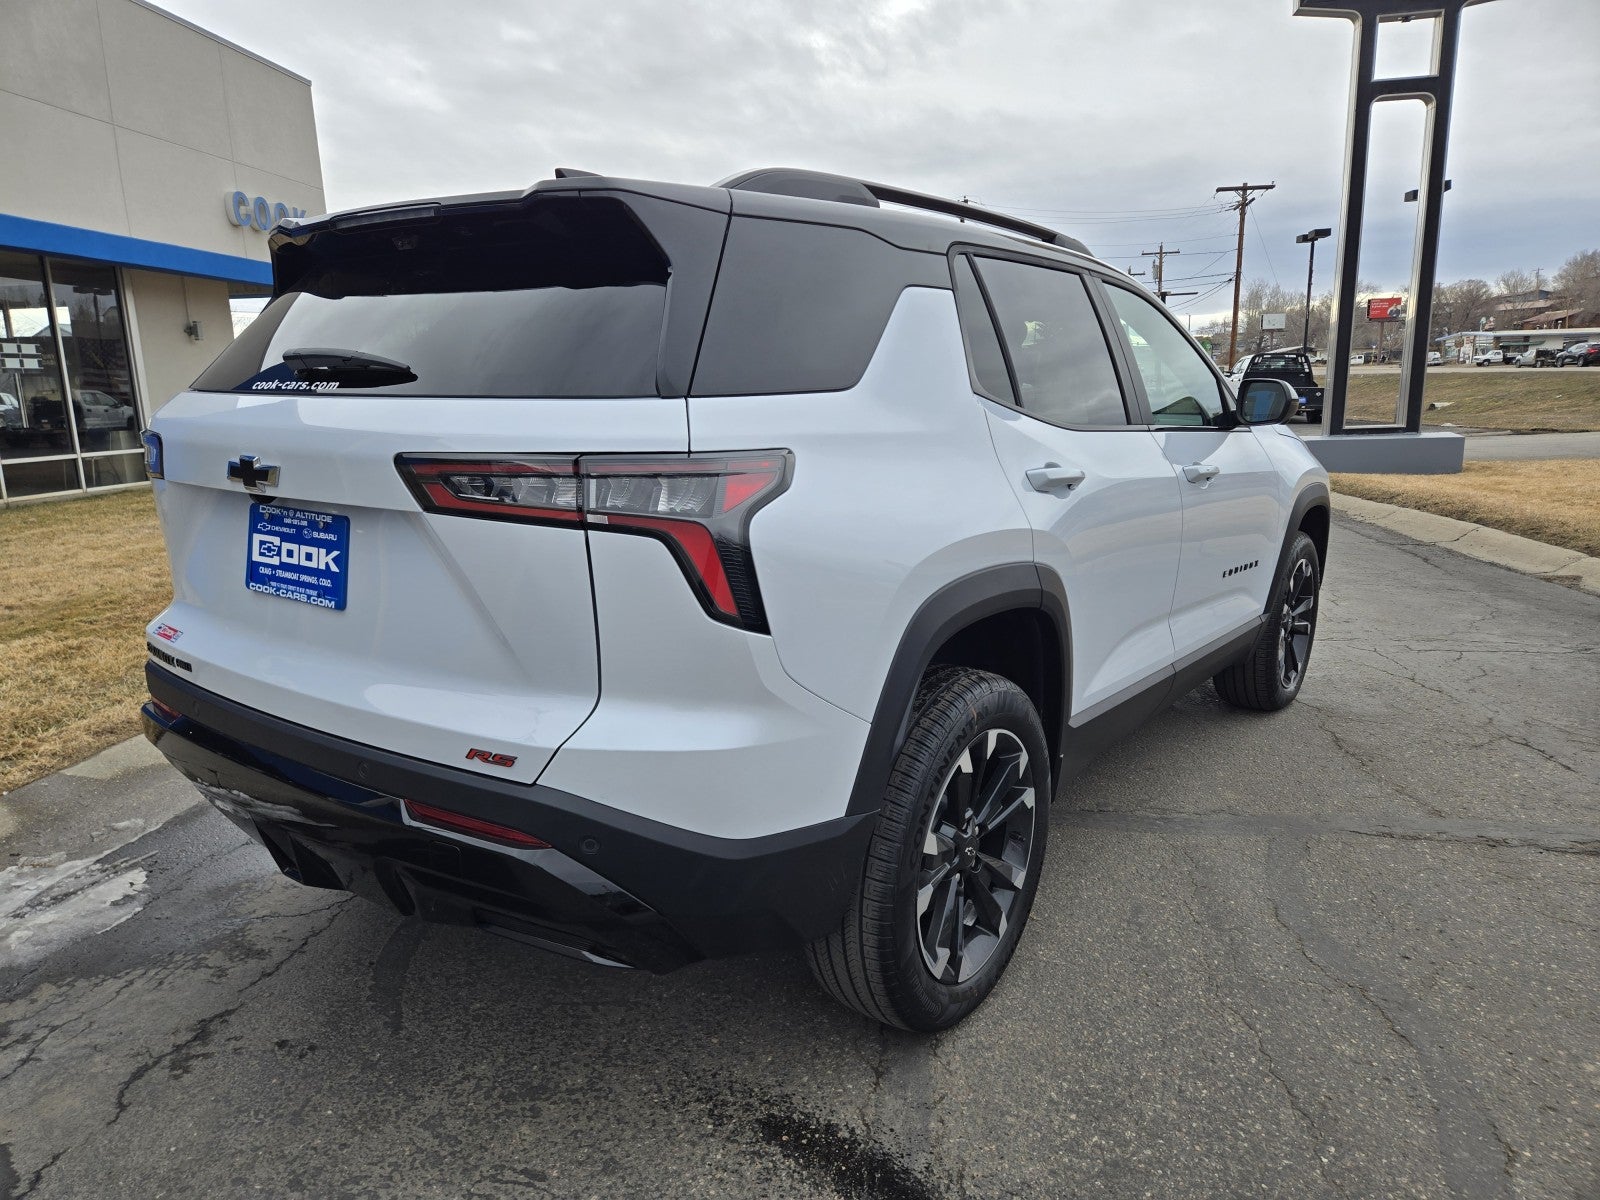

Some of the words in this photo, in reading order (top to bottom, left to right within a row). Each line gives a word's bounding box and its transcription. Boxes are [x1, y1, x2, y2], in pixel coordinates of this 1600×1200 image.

[252, 379, 340, 390] cook-cars.com
[295, 511, 333, 523] ALTITUDE
[271, 525, 297, 534] CHEVROLET
[312, 531, 338, 541] SUBARU
[252, 533, 340, 573] COOK
[275, 569, 299, 581] STEAMBOAT
[249, 582, 336, 609] COOK-CARS.COM
[465, 748, 518, 767] RS
